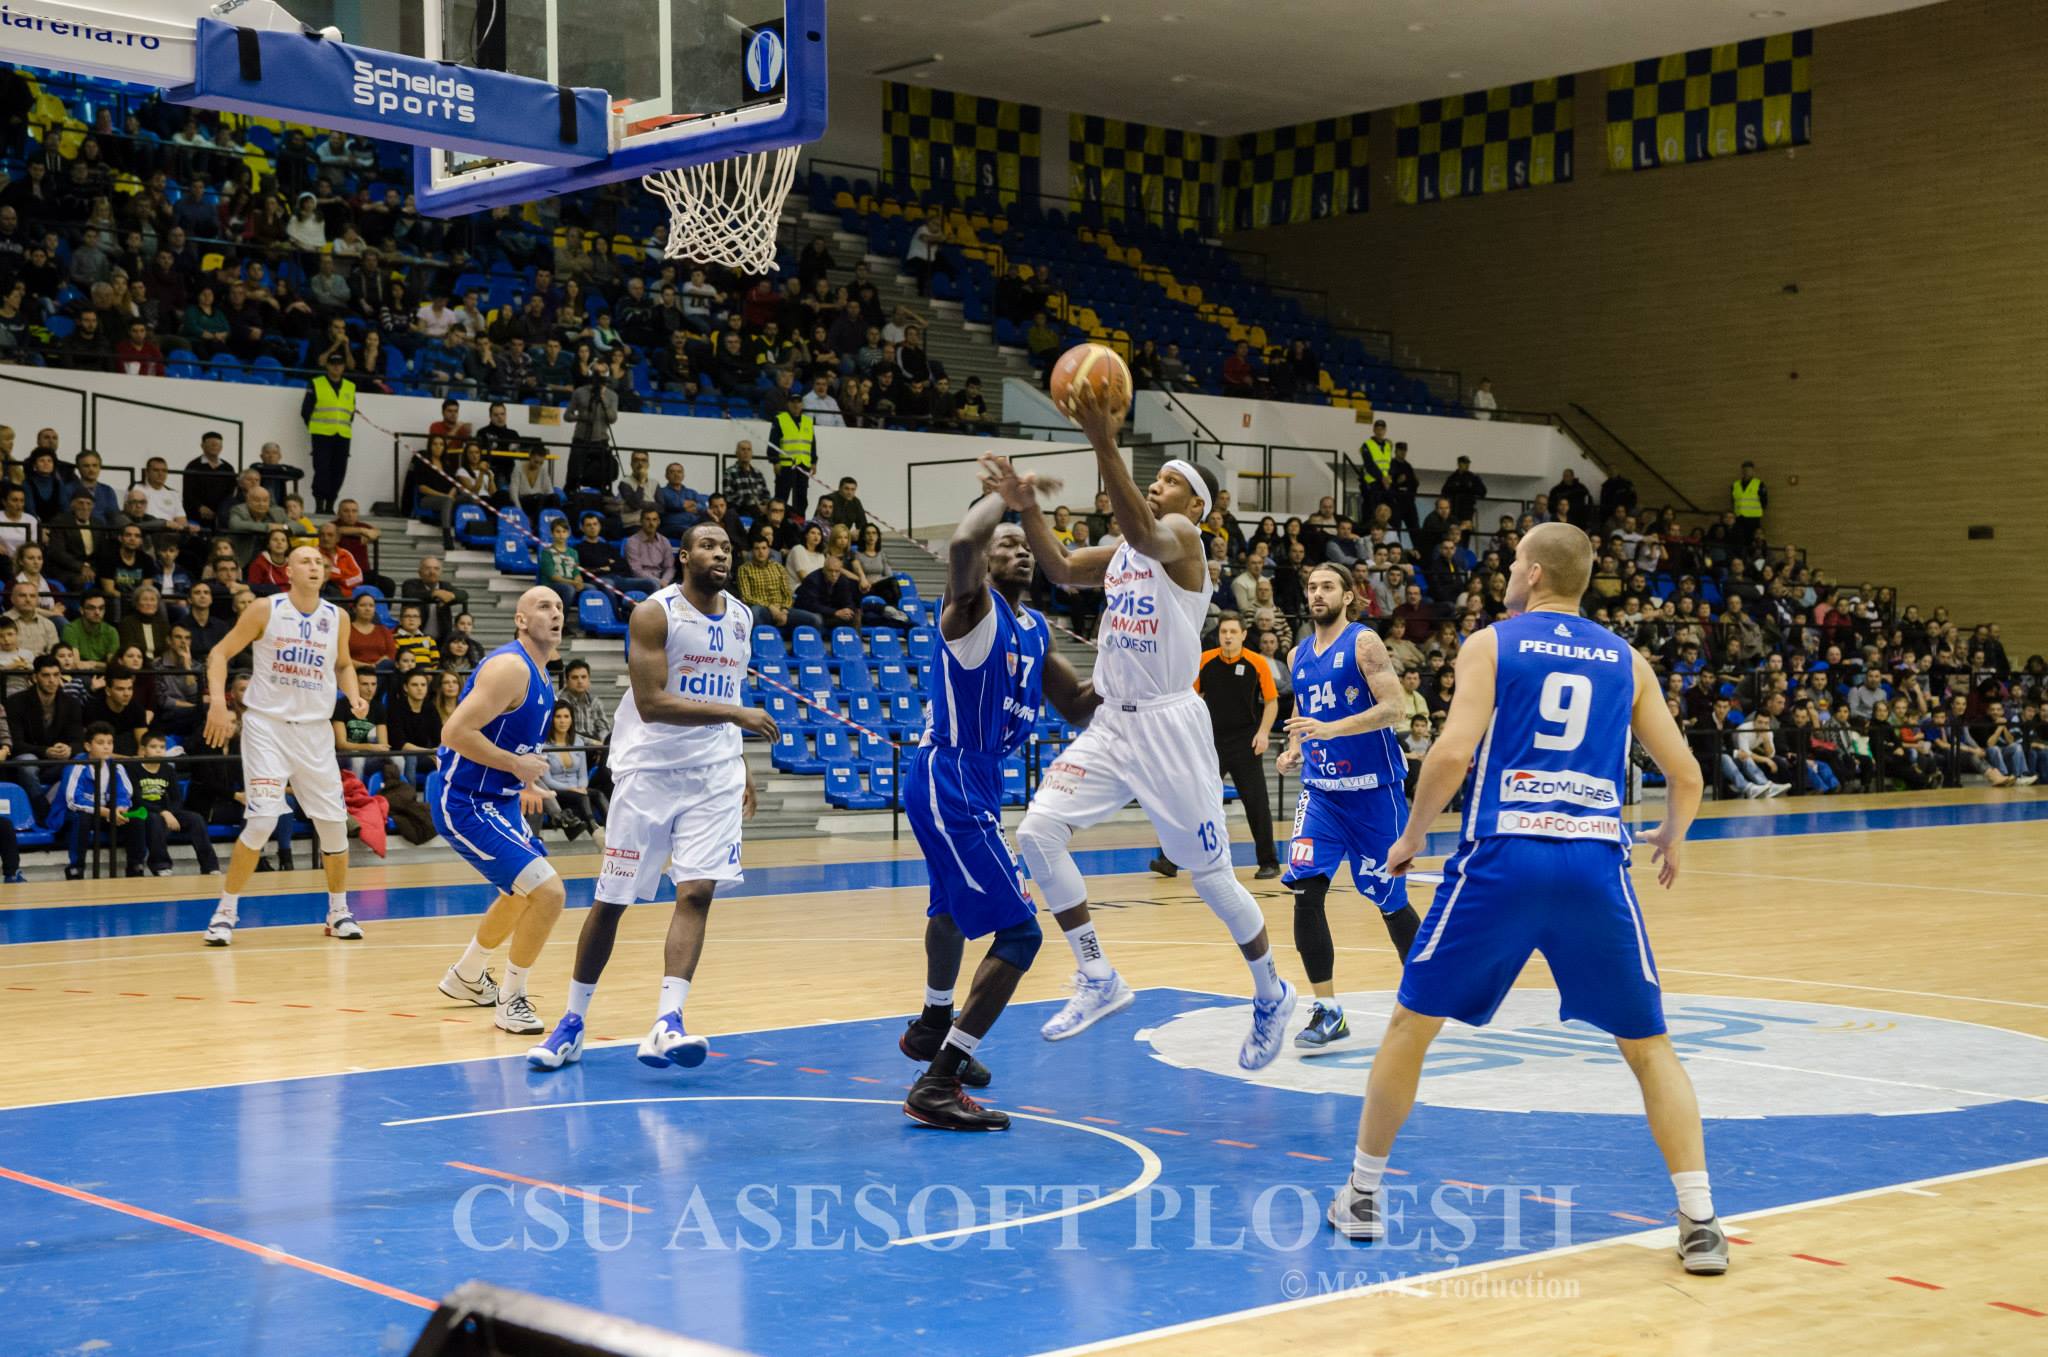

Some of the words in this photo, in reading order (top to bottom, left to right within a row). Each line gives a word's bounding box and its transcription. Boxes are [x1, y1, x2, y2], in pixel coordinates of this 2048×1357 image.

[353, 60, 475, 102] Schelde
[353, 82, 476, 123] Sports
[1612, 113, 1811, 168] PLOIESTI
[298, 620, 312, 640] 10
[707, 625, 724, 652] 20
[276, 645, 325, 668] idilis
[682, 653, 718, 665] super
[1519, 639, 1619, 663] PECIUKAS
[679, 671, 735, 699] idilis
[1019, 654, 1035, 688] 7
[1308, 680, 1337, 714] 24
[1533, 671, 1593, 751] 9
[1513, 780, 1615, 803] AZOMURES
[1198, 820, 1217, 852] 13
[1519, 816, 1618, 835] DAFCOCHIM
